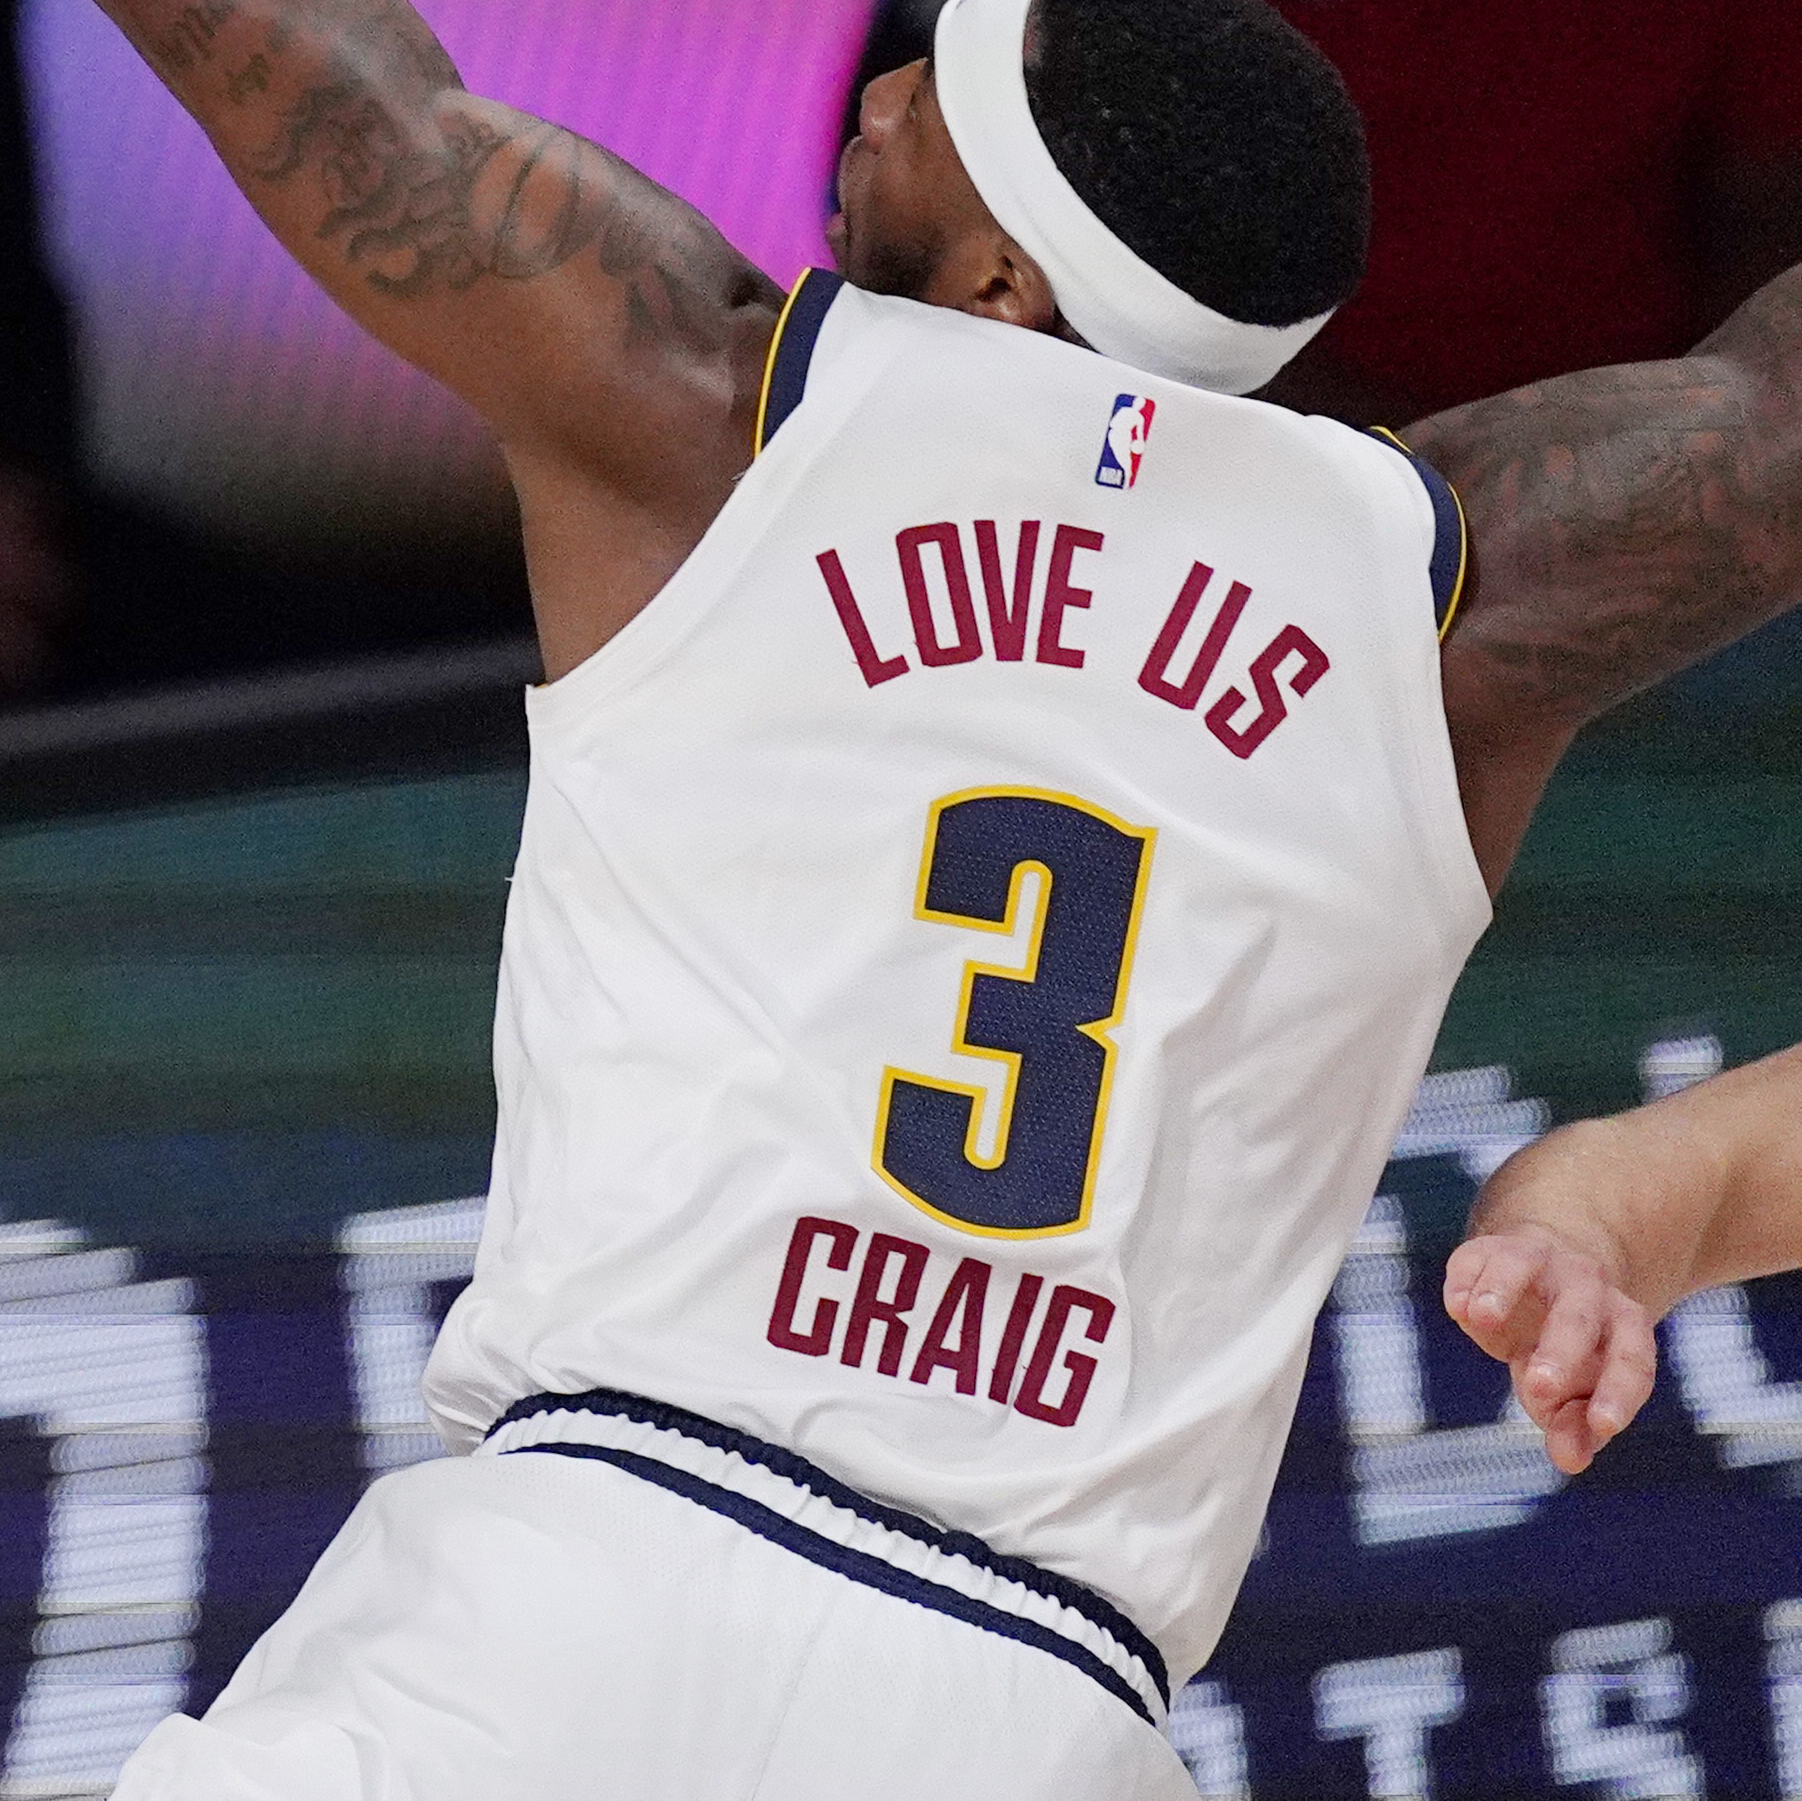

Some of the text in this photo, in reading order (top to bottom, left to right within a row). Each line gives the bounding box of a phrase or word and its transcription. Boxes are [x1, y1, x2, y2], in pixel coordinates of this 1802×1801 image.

[815, 519, 1330, 760] LOVE US
[871, 784, 1158, 1239] 3
[765, 1216, 1116, 1428] CRAIG
